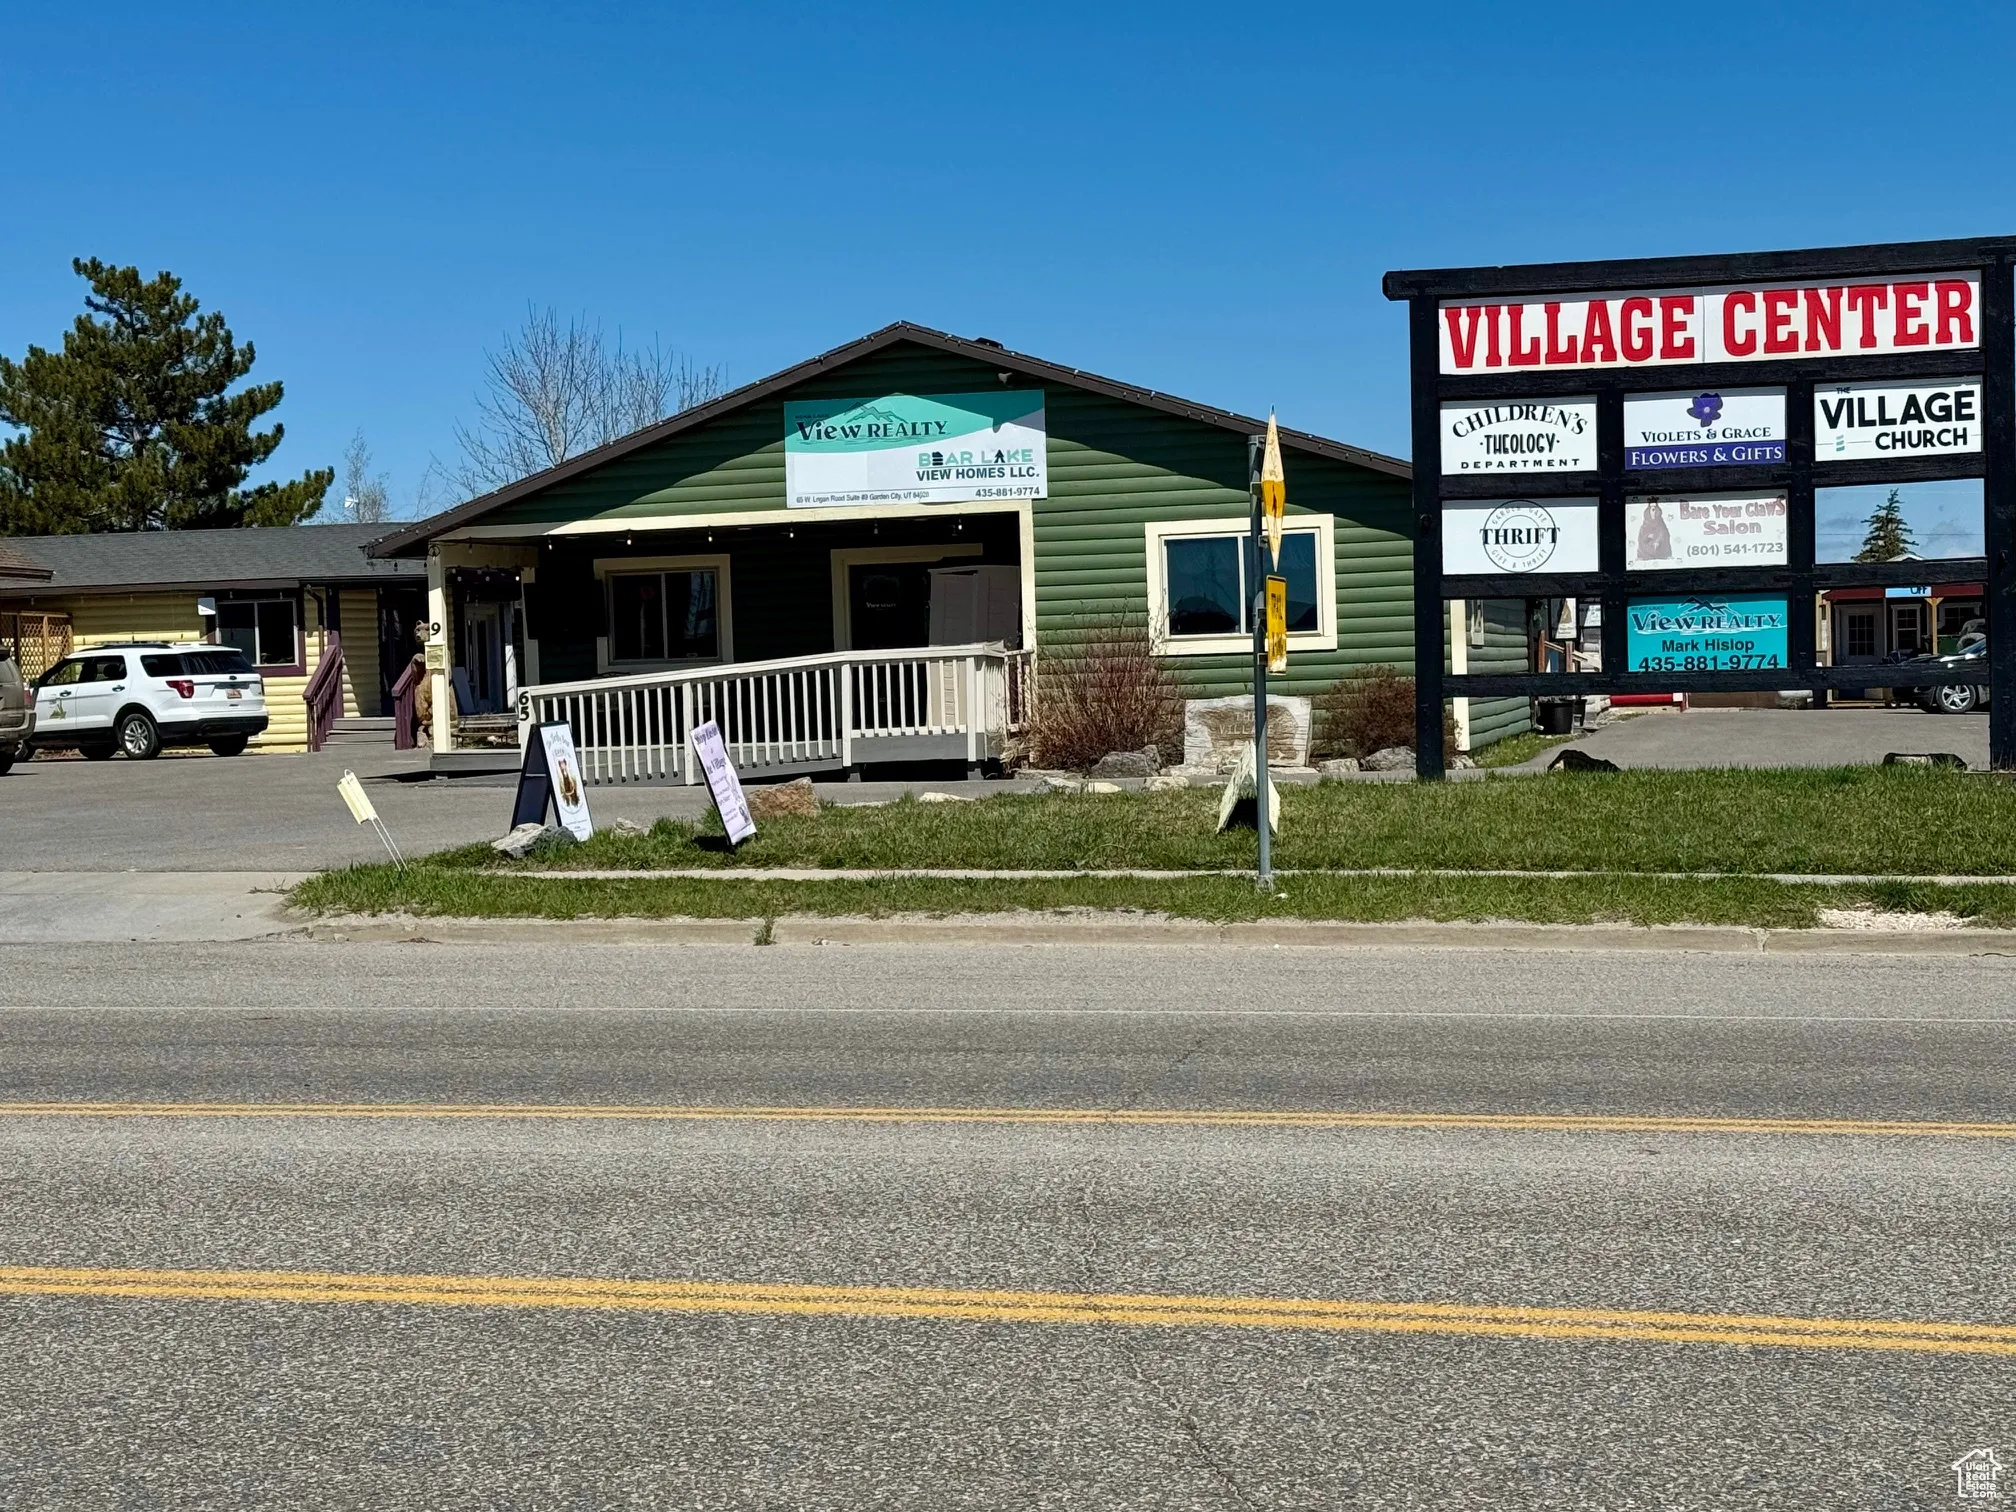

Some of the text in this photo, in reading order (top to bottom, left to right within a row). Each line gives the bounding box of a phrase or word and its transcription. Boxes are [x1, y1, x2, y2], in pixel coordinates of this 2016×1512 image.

[1444, 278, 1974, 368] VILLAGE CENTER
[1836, 386, 1851, 394] THE
[1820, 390, 1975, 429] VILLAGE
[1452, 403, 1588, 438] CHILDREN'S
[796, 418, 948, 441] View REALTY
[1641, 427, 1771, 443] VIOLETS & GRACE
[1875, 427, 1968, 450] CHURCH
[1460, 458, 1580, 469] DEPARTMENT
[1631, 446, 1783, 466] FLOWERS & GIFTS
[916, 466, 1040, 481] VIEW HOMES LLC.
[870, 493, 889, 501] Garden
[975, 487, 1040, 498] 435-881-9774
[1679, 499, 1710, 520] Bare
[1712, 503, 1743, 519] Your
[1479, 527, 1561, 545] THRIFT
[1703, 521, 1761, 536] Salon
[1686, 542, 1784, 557] (801) 541-1723
[1631, 609, 1696, 631] View
[1701, 613, 1783, 629] REALTY
[431, 621, 441, 636] 9
[1662, 638, 1755, 653] Mark Hislop
[1638, 653, 1779, 673] 435-881-9774
[1235, 711, 1255, 721] TH
[1219, 724, 1275, 735] VILLE
